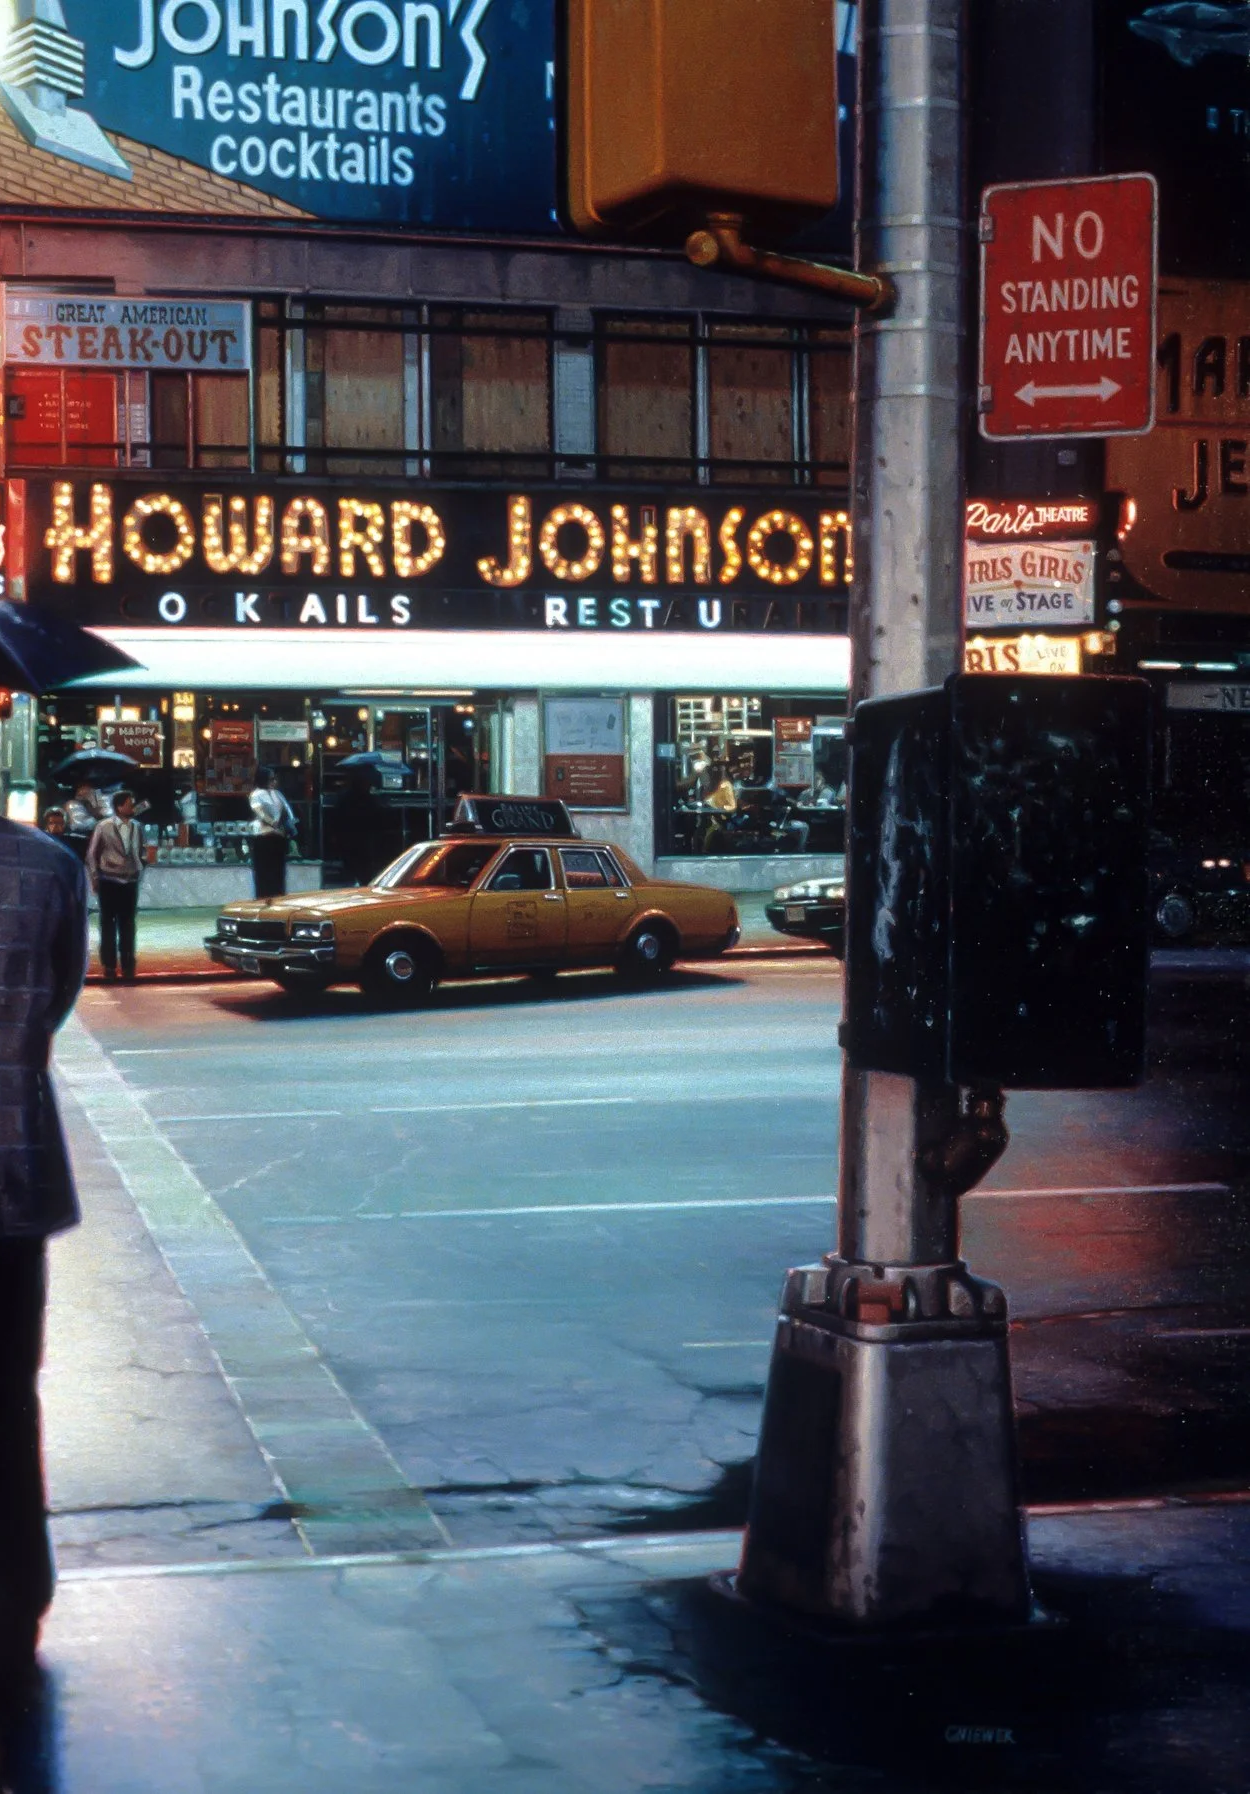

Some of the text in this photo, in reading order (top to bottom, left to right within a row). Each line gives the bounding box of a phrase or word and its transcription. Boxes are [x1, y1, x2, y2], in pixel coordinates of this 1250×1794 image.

[171, 65, 447, 137] Restaurants
[210, 131, 414, 186] cocktails
[1031, 210, 1104, 264] NO
[1000, 274, 1139, 314] STANDING
[55, 303, 208, 326] GREAT AMERICAN
[20, 324, 238, 364] STEAK-OUT
[1004, 327, 1132, 364] ANYTIME
[44, 480, 853, 588] HOWARD JOHNSON
[966, 502, 1088, 534] Paris THEATRE
[1019, 551, 1086, 585] GIRLS
[1016, 592, 1074, 612] STAGE
[1036, 645, 1069, 660] LIVE
[118, 726, 156, 736] HAPPY
